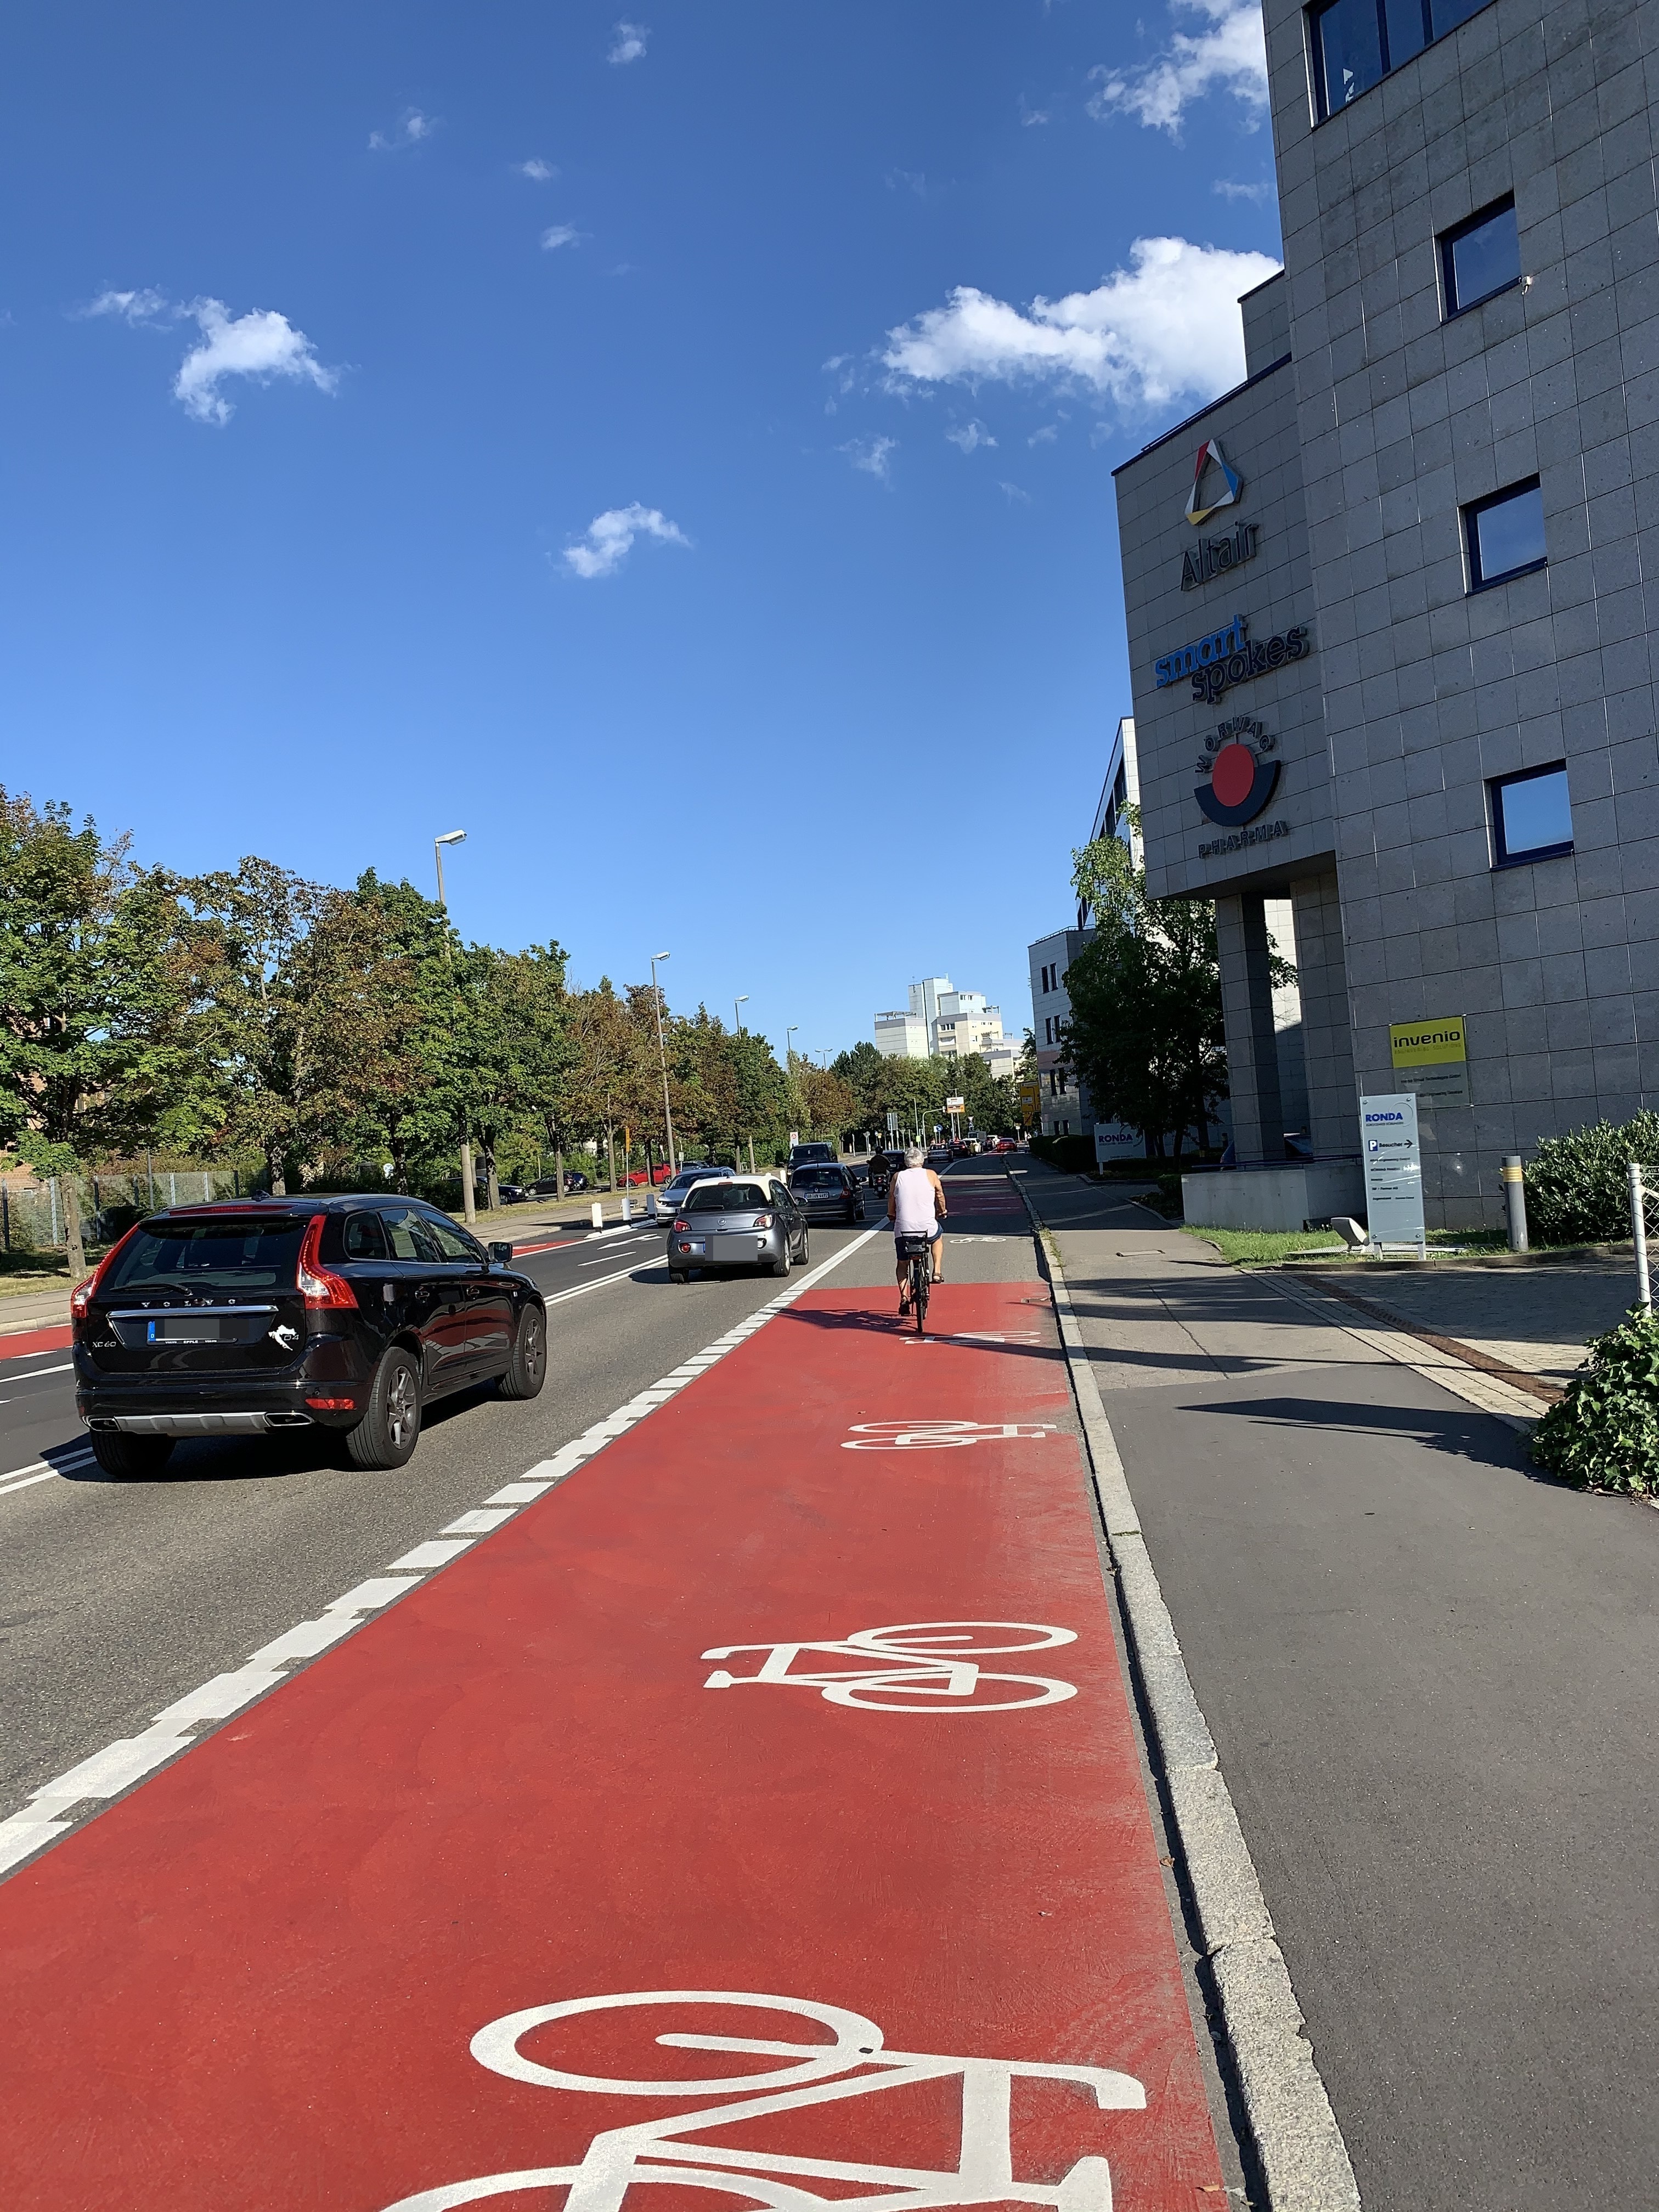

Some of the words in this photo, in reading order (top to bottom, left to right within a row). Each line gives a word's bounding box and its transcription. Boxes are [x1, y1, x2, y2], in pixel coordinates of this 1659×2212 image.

[1181, 521, 1259, 591] Altair
[1155, 614, 1246, 687] smart
[1191, 627, 1307, 704] spokes
[1198, 821, 1285, 859] PHARMA
[1393, 1030, 1460, 1048] invenio
[1365, 1112, 1403, 1122] RONDA
[1098, 1133, 1133, 1143] RONDA
[141, 1299, 236, 1308] VOLVO
